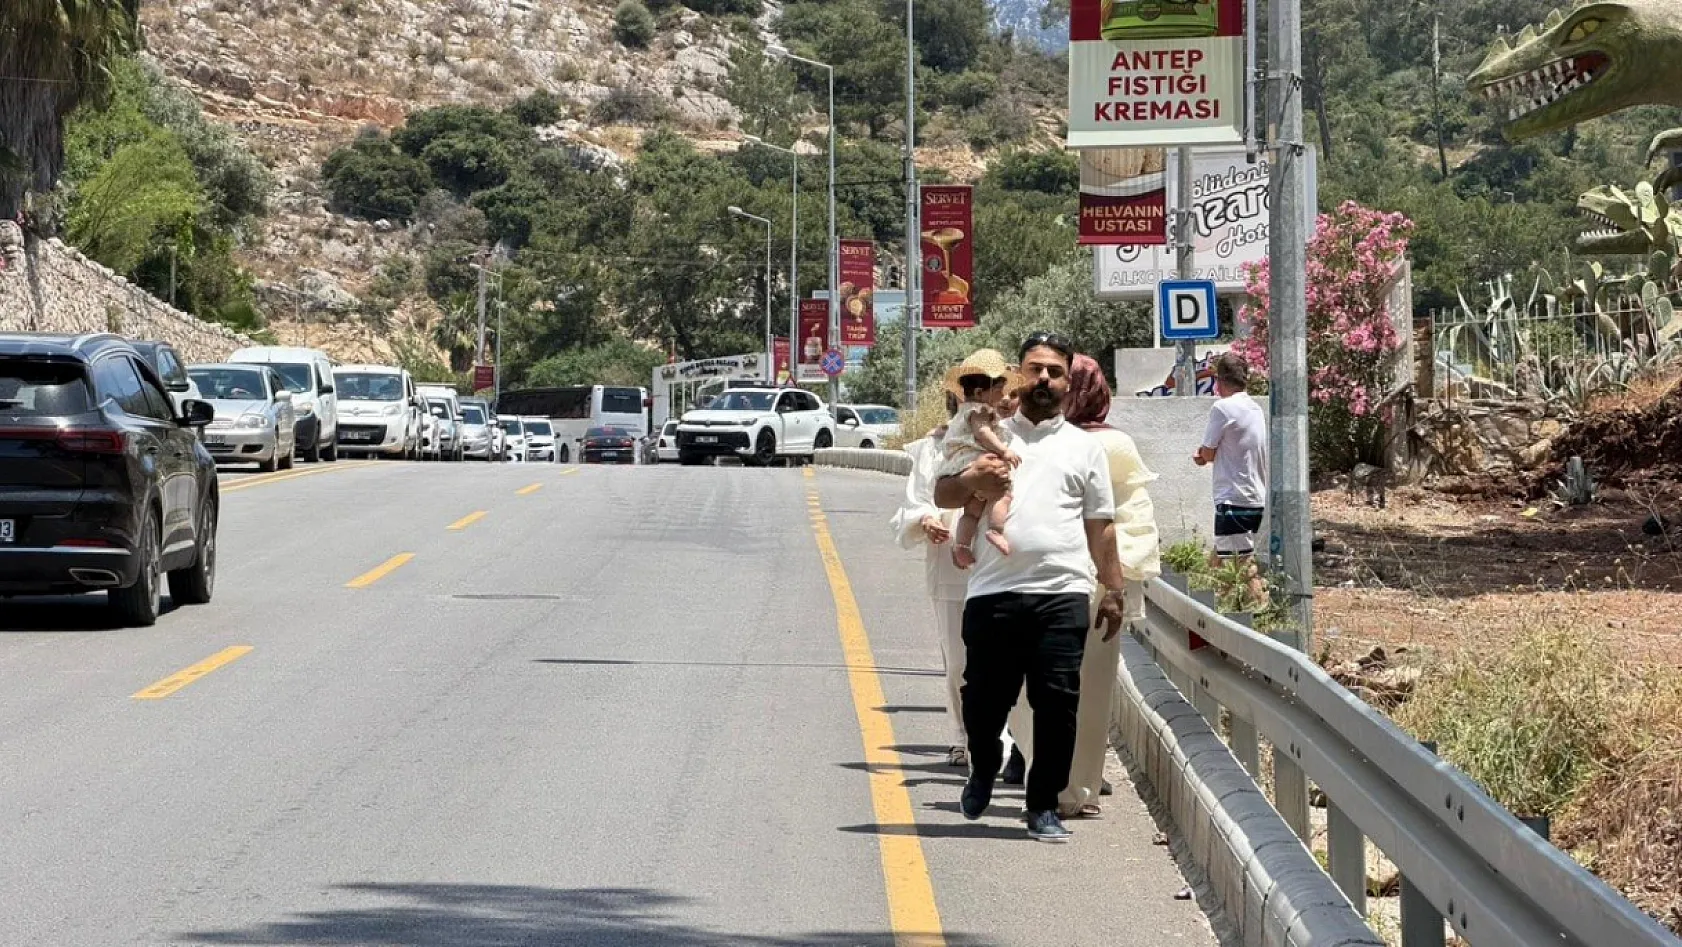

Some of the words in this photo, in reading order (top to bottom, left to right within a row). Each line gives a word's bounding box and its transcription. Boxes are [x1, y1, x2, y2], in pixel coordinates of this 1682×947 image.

[1111, 50, 1203, 71] ANTEP
[1108, 68, 1206, 96] FISTIĞI
[1095, 99, 1219, 121] KREMASI
[926, 192, 967, 204] SERVET
[1083, 204, 1163, 218] HELVANIN
[1094, 219, 1152, 232] USTASI
[841, 246, 870, 256] SERVET
[1176, 294, 1200, 324] D
